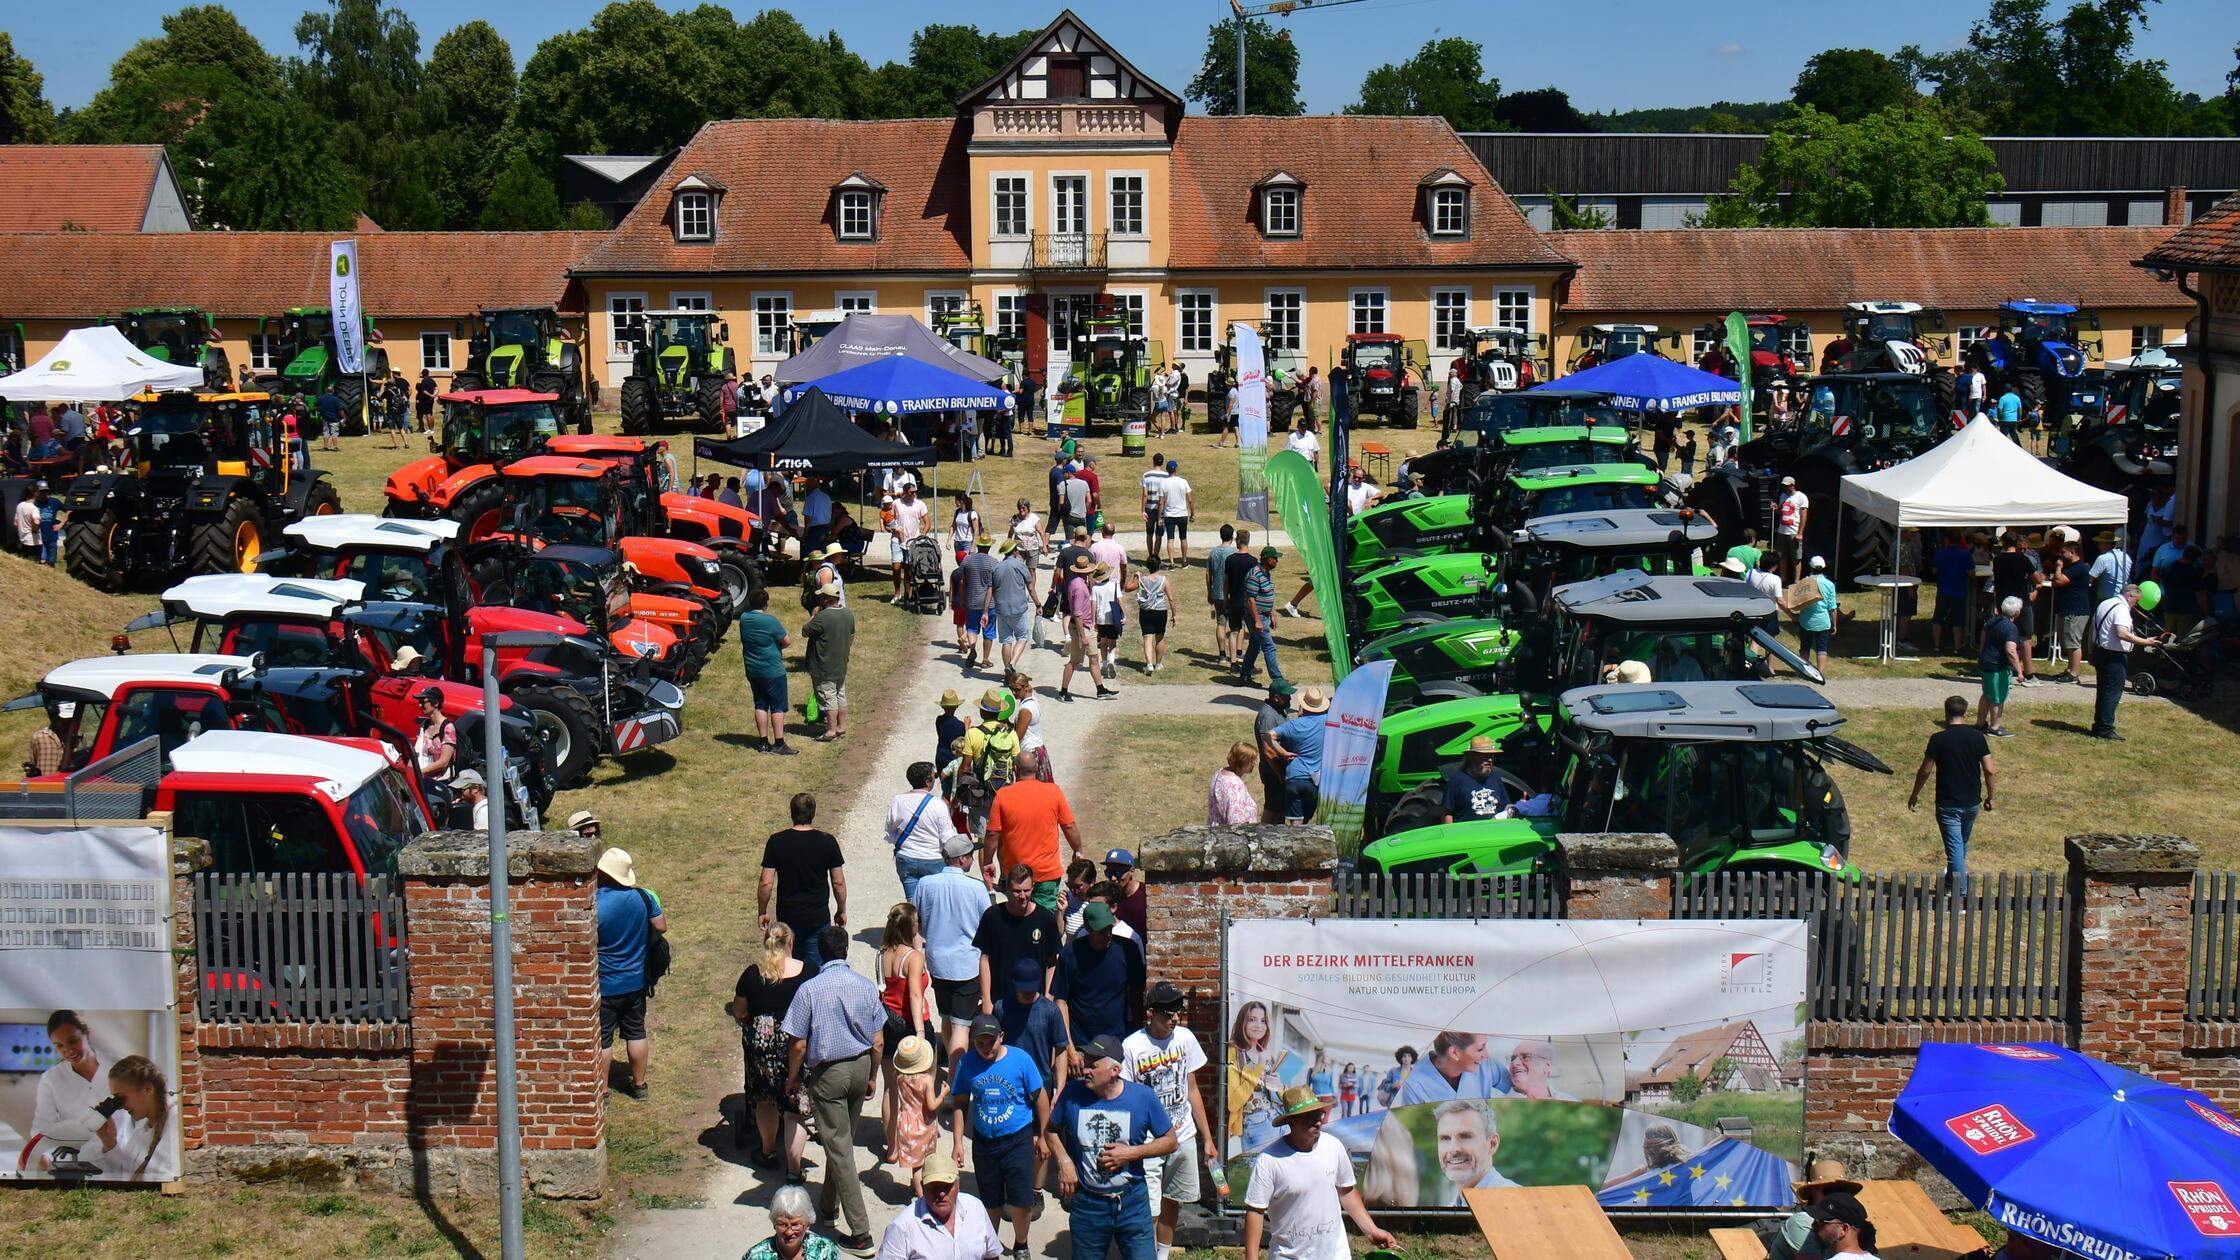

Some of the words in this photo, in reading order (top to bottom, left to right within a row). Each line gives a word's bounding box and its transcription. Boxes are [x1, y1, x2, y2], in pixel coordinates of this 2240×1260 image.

[833, 394, 871, 409] BRUNNEN
[902, 398, 949, 411] FRANKEN
[950, 396, 998, 410] BRUNNEN
[1611, 395, 1640, 409] NNEN
[1672, 392, 1709, 408] FRANKEN
[775, 458, 813, 469] STIGA
[1431, 598, 1474, 608] DEUTZ-FA
[1263, 954, 1291, 967] DER
[1296, 954, 1349, 967] BEZIRK
[1353, 954, 1475, 967] MITTELFRANKEN
[1720, 952, 1728, 986] BEZIRK
[1298, 973, 1340, 983] SOZIALES
[1342, 973, 1383, 982] BILDUNG
[1385, 973, 1442, 982] GESUNDHEIT
[1443, 973, 1476, 982] KULTUR
[1349, 986, 1378, 995] NATUR
[1380, 986, 1399, 995] UND
[1401, 986, 1439, 995] UMWELT
[1440, 986, 1476, 995] EUROPA
[993, 1104, 1015, 1125] JONES
[1971, 1115, 2007, 1144] SPRUDEL
[1982, 1109, 2022, 1141] RHÖN
[2176, 1188, 2224, 1204] RHÖN
[2188, 1204, 2232, 1213] SPRUDEL
